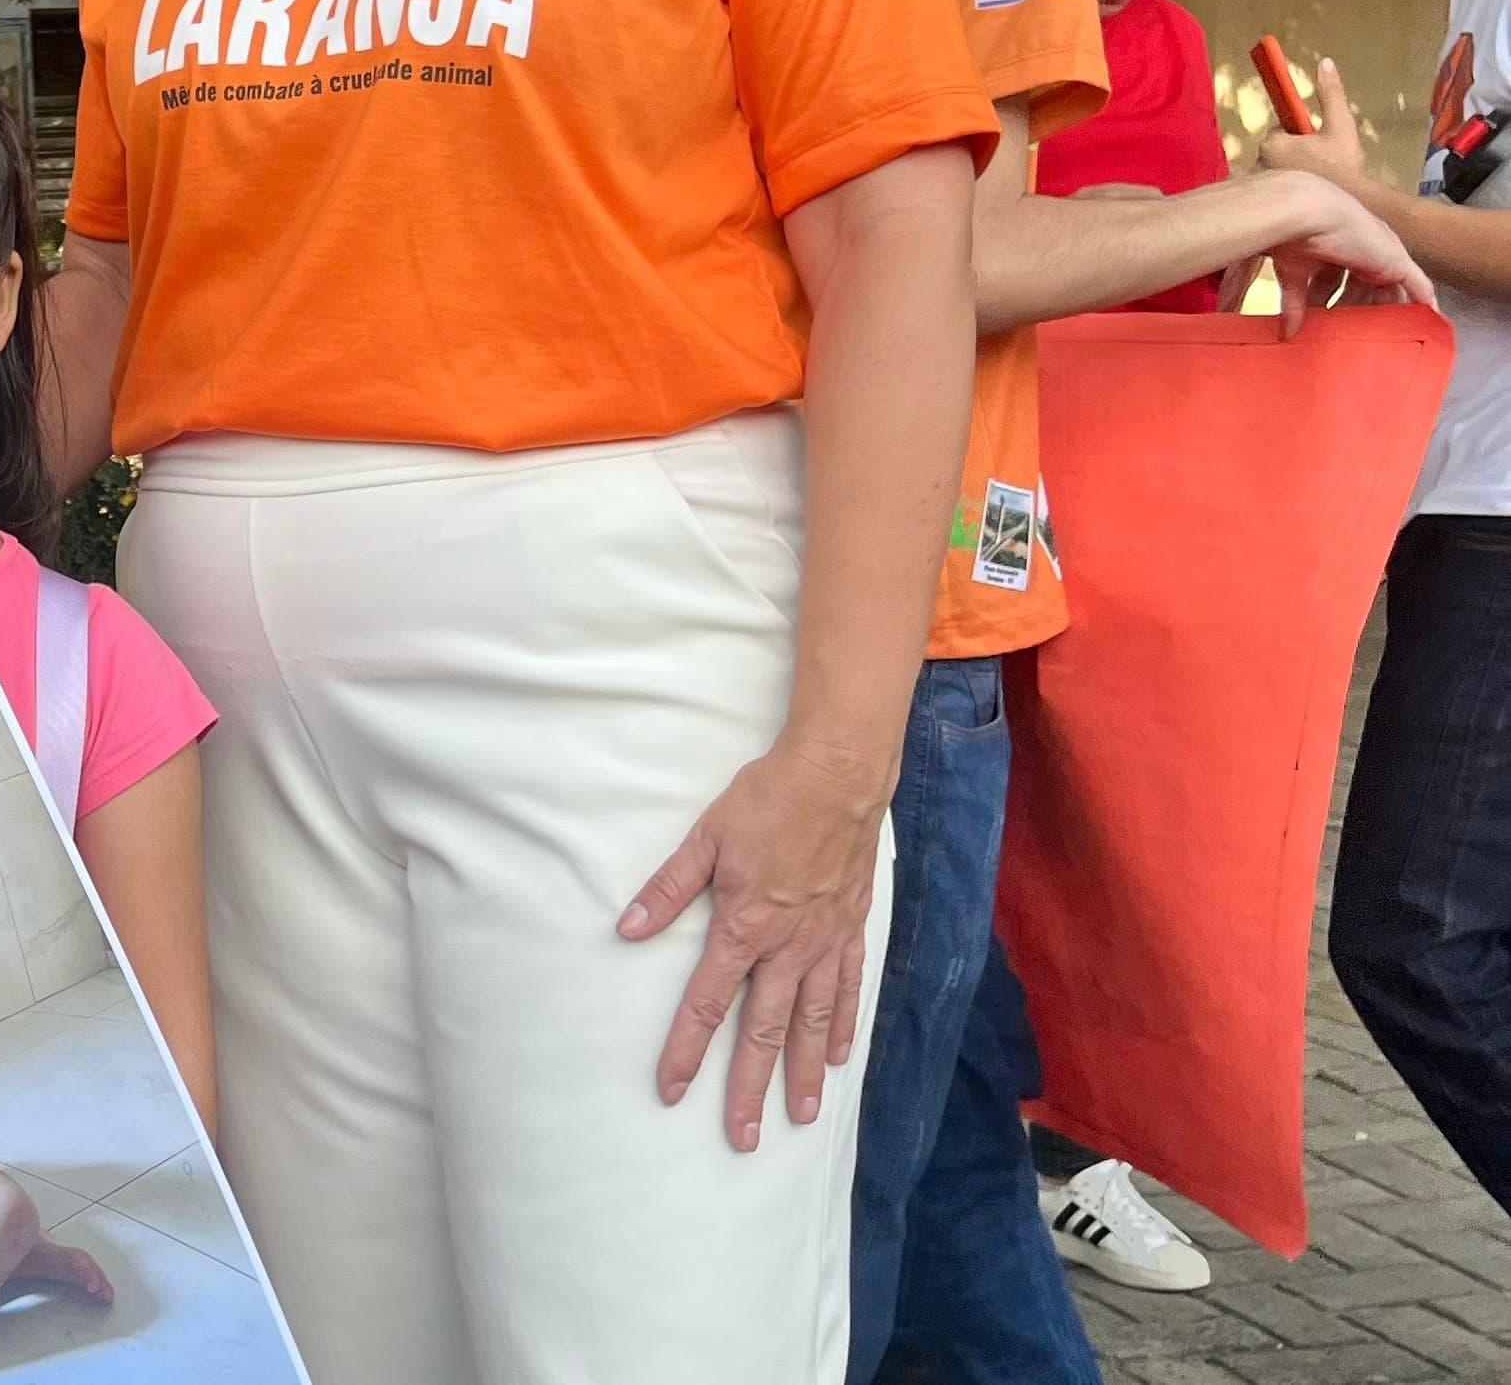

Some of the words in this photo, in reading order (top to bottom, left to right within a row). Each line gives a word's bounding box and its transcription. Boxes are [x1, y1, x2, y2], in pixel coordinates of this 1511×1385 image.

[195, 82, 217, 102] de
[224, 80, 304, 101] combate
[311, 75, 323, 95] à
[421, 64, 493, 88] animal
